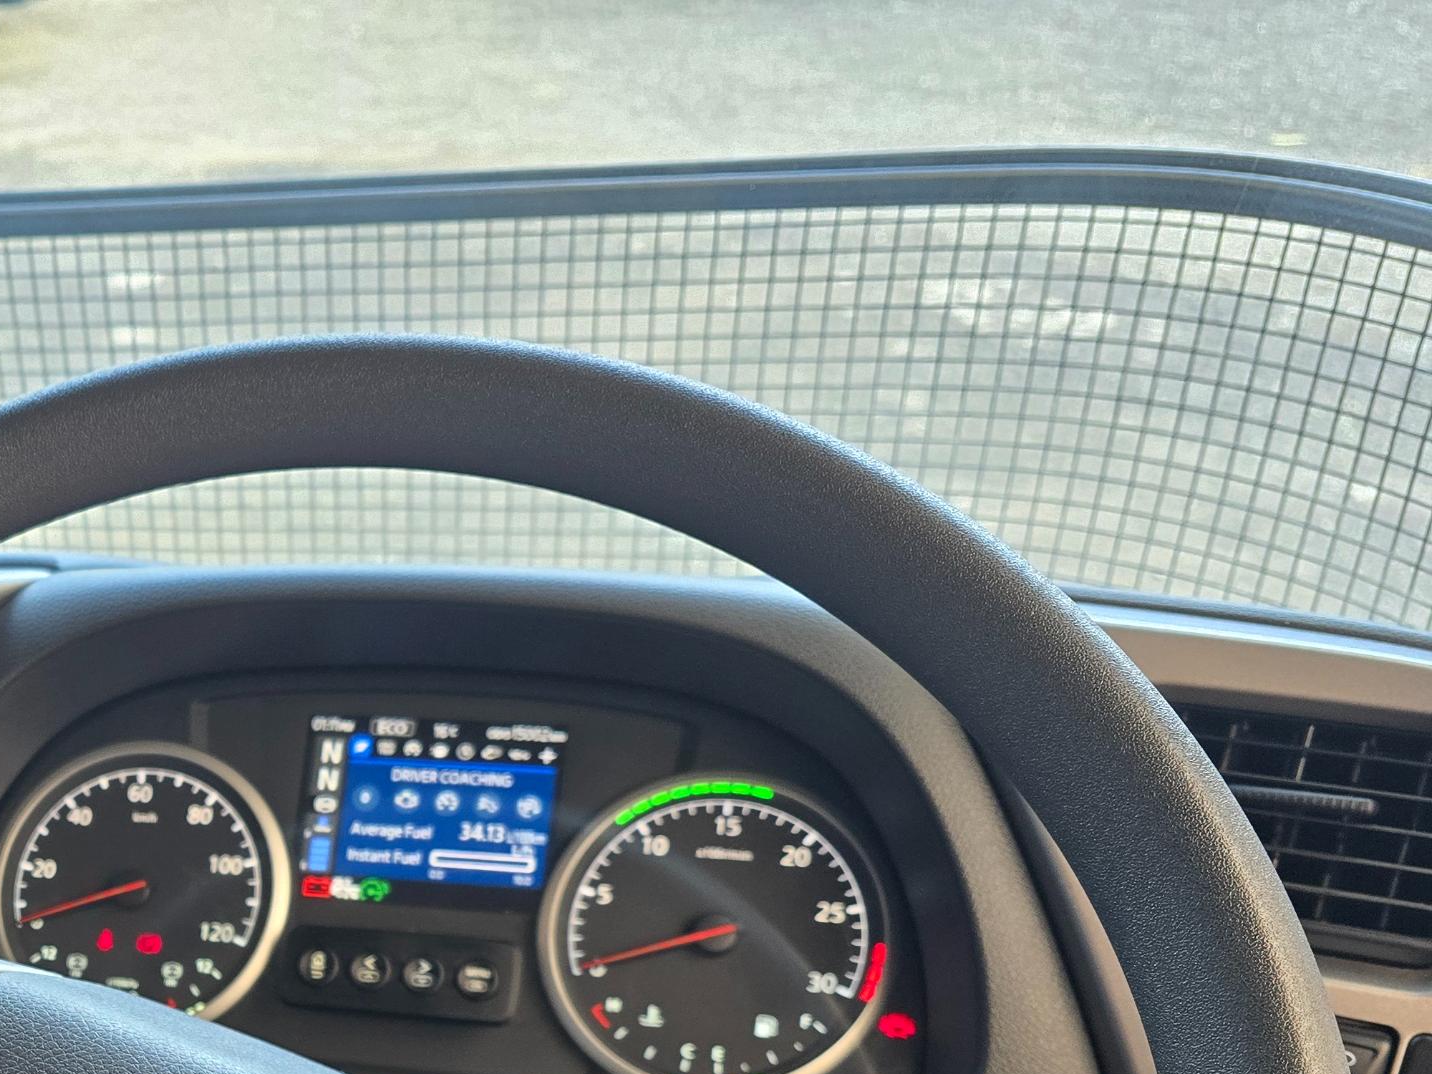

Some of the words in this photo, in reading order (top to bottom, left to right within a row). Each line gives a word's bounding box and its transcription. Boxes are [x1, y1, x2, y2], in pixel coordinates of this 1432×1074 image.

[320, 738, 345, 765] N
[317, 767, 341, 792] N
[391, 767, 438, 784] DRIVER
[439, 769, 515, 788] COACHING
[127, 783, 153, 804] 60
[67, 806, 93, 827] 40
[187, 804, 213, 825] 80
[350, 820, 404, 842] Average
[405, 823, 434, 840] Fuel
[714, 816, 743, 837] 15
[641, 835, 670, 856] 10
[209, 854, 244, 876] 100
[347, 847, 391, 864] Instant
[393, 851, 422, 866] Fuel
[779, 846, 812, 868] 20
[31, 858, 57, 880] 20
[597, 884, 614, 905] 5
[814, 901, 847, 924] 25
[200, 922, 235, 943] 120
[806, 971, 838, 994] 30
